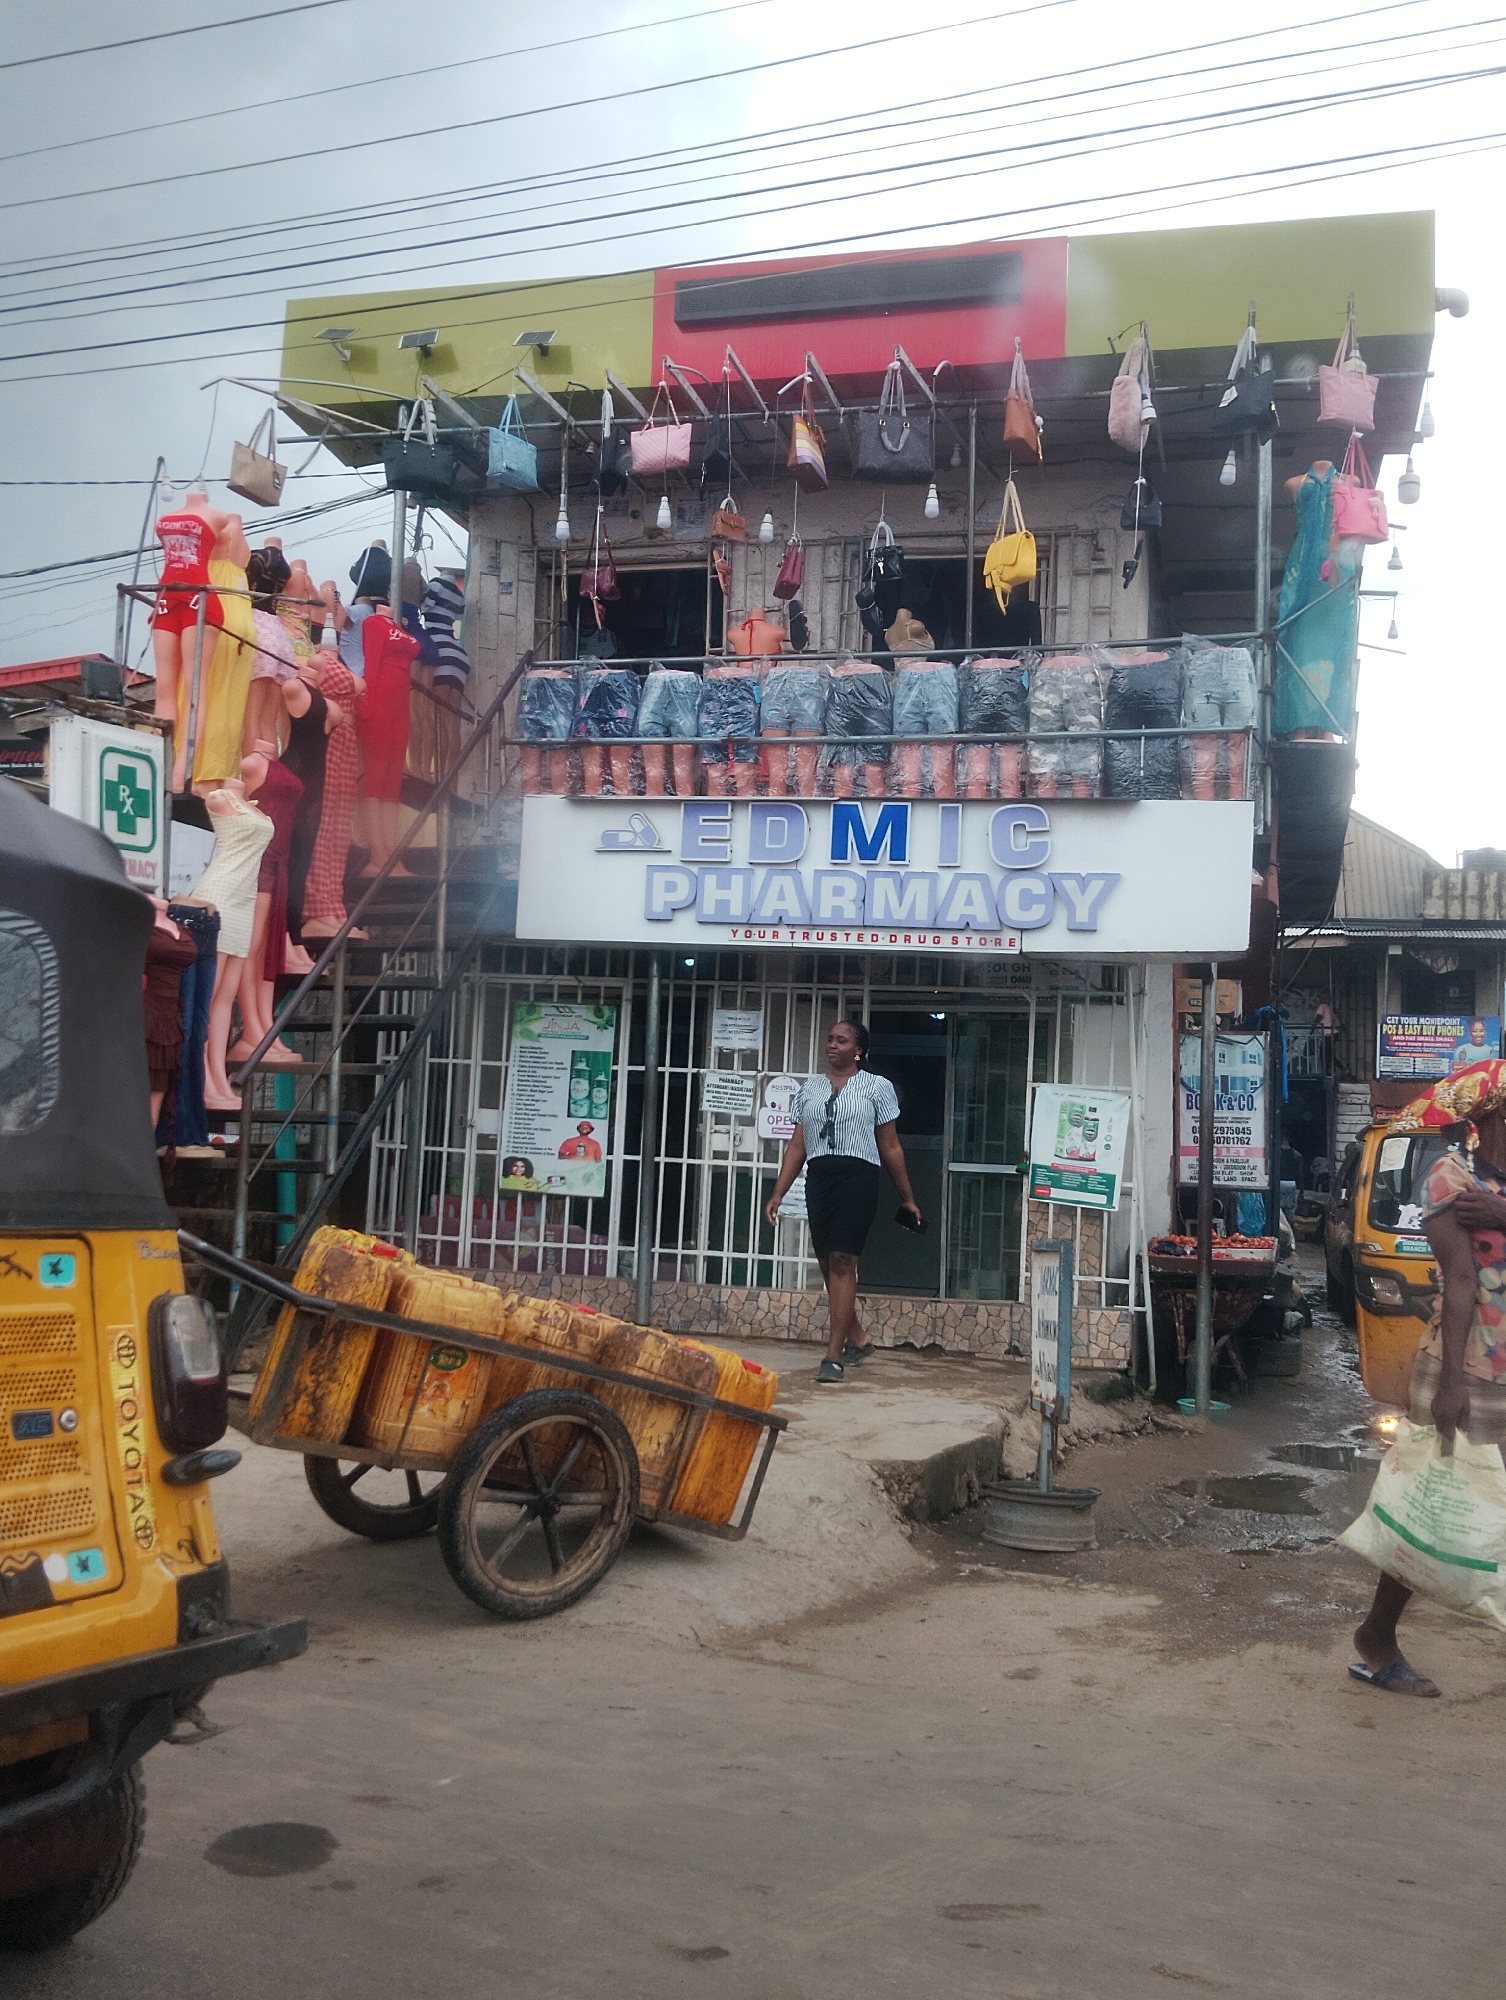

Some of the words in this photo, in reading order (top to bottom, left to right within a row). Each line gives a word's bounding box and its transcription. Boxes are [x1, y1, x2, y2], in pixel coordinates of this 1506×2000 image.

[644, 864, 1122, 932] PHARMACY
[731, 928, 779, 940] YOUR
[789, 930, 879, 944] TRUSTED
[889, 934, 941, 945] DRUG
[951, 935, 1016, 948] STORE
[1386, 1016, 1399, 1025] GET
[1400, 1016, 1418, 1025] YOUR
[1382, 1024, 1397, 1034] POS
[1404, 1025, 1421, 1036] EASY
[1422, 1025, 1436, 1036] BUY
[1437, 1026, 1464, 1037] PHONES
[767, 1114, 792, 1126] OPE
[117, 1377, 146, 1515] TOYOTA
